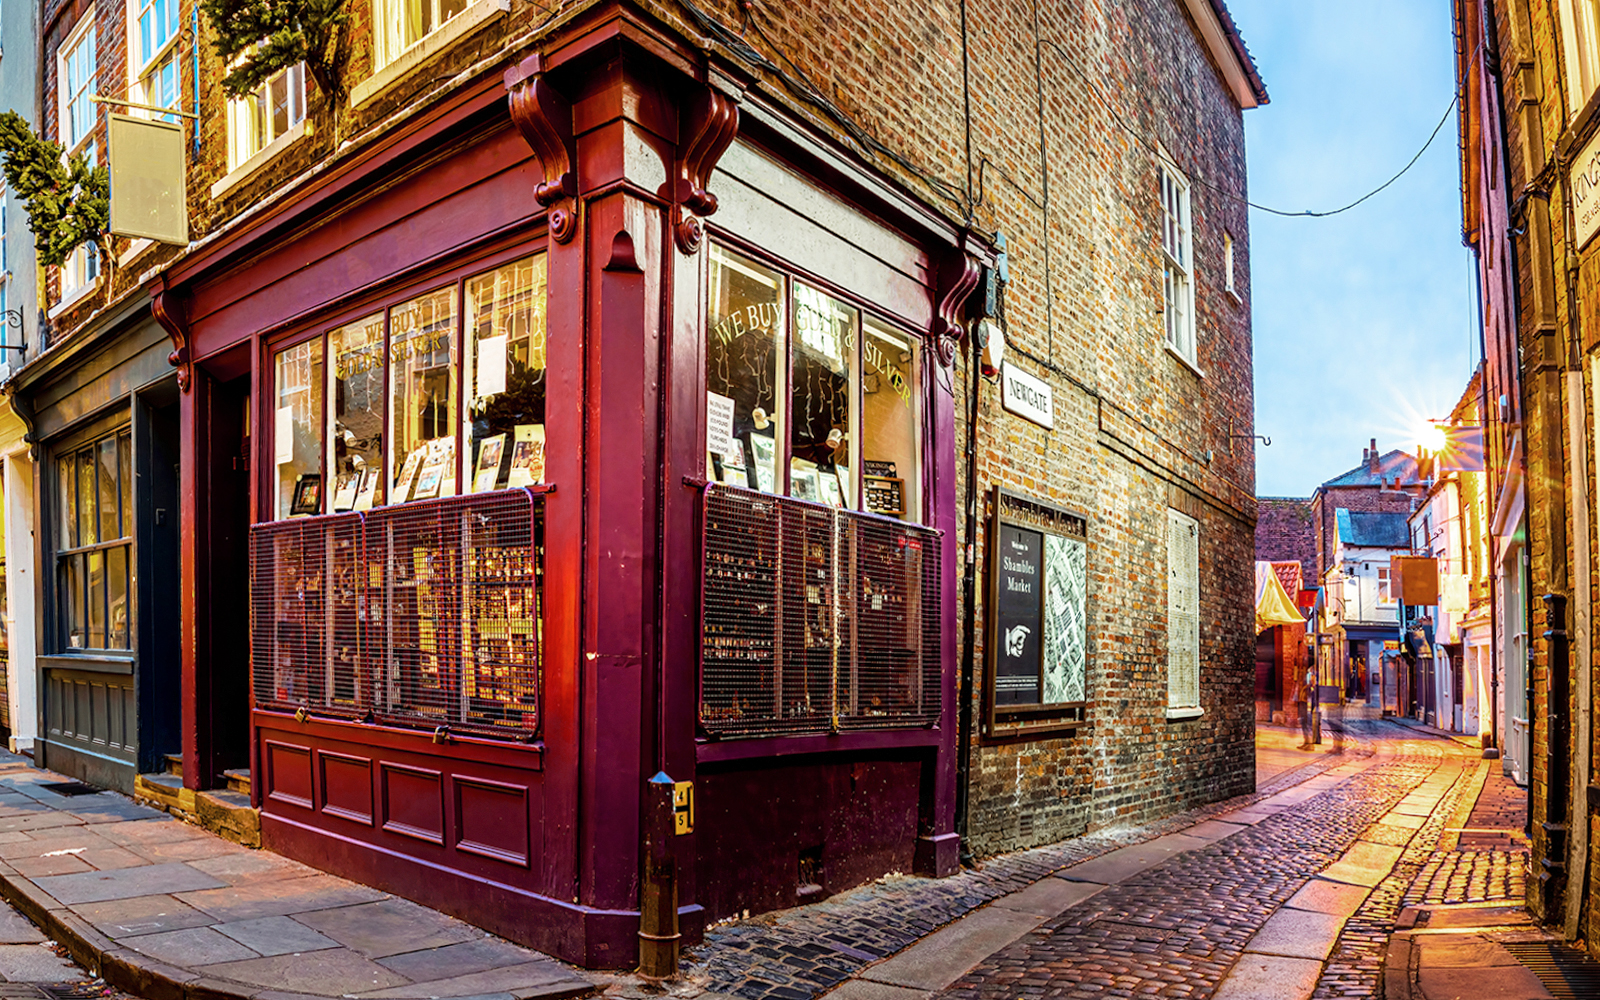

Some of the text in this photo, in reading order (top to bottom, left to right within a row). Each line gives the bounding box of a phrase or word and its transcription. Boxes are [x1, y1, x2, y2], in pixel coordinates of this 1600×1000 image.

[391, 307, 421, 336] BUY
[391, 330, 442, 363] SILVER
[714, 303, 911, 409] WE BUY GOLD & SILVER
[1009, 377, 1048, 414] NEWGATE
[1003, 556, 1035, 575] Shambles
[1007, 576, 1031, 594] Market
[676, 791, 684, 802] 4
[679, 815, 684, 826] 5
